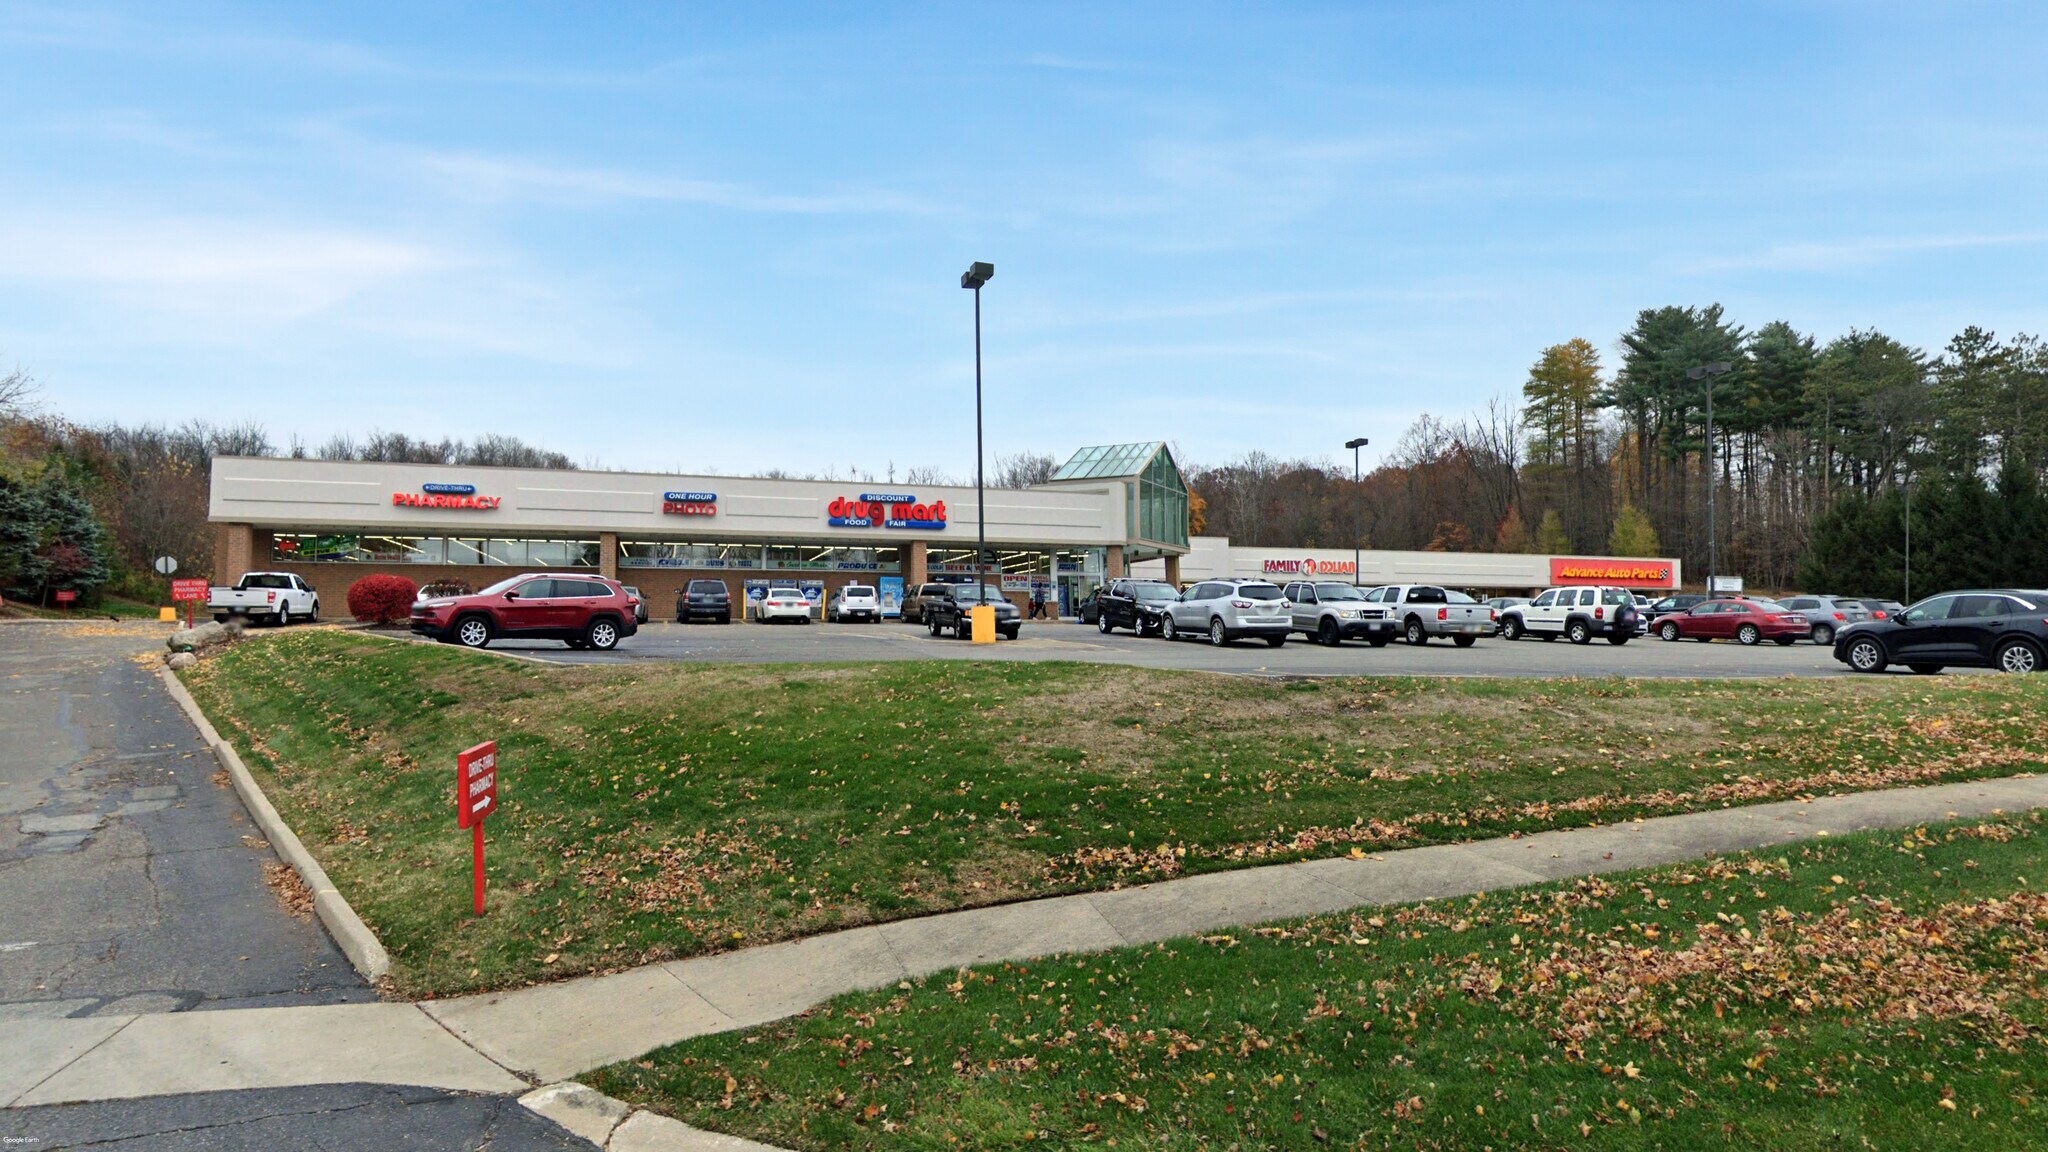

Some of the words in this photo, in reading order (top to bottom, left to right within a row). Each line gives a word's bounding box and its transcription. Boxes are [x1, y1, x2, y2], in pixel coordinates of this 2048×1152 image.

[430, 484, 468, 492] DRIVE-THRU
[392, 493, 502, 511] PHARMACY
[867, 494, 909, 502] DISCOUNT
[663, 502, 718, 516] PHOTO
[828, 496, 885, 527] drug
[891, 500, 947, 521] mart
[837, 562, 877, 570] PRODUCE
[1263, 559, 1301, 572] FAMILY
[1319, 561, 1356, 574] DOLLAR
[1561, 566, 1604, 578] Advance
[1604, 567, 1631, 578] Auto
[1631, 568, 1659, 579] Parts
[468, 753, 495, 778] DRIVE-THRU
[470, 772, 494, 798] PHARMACY
